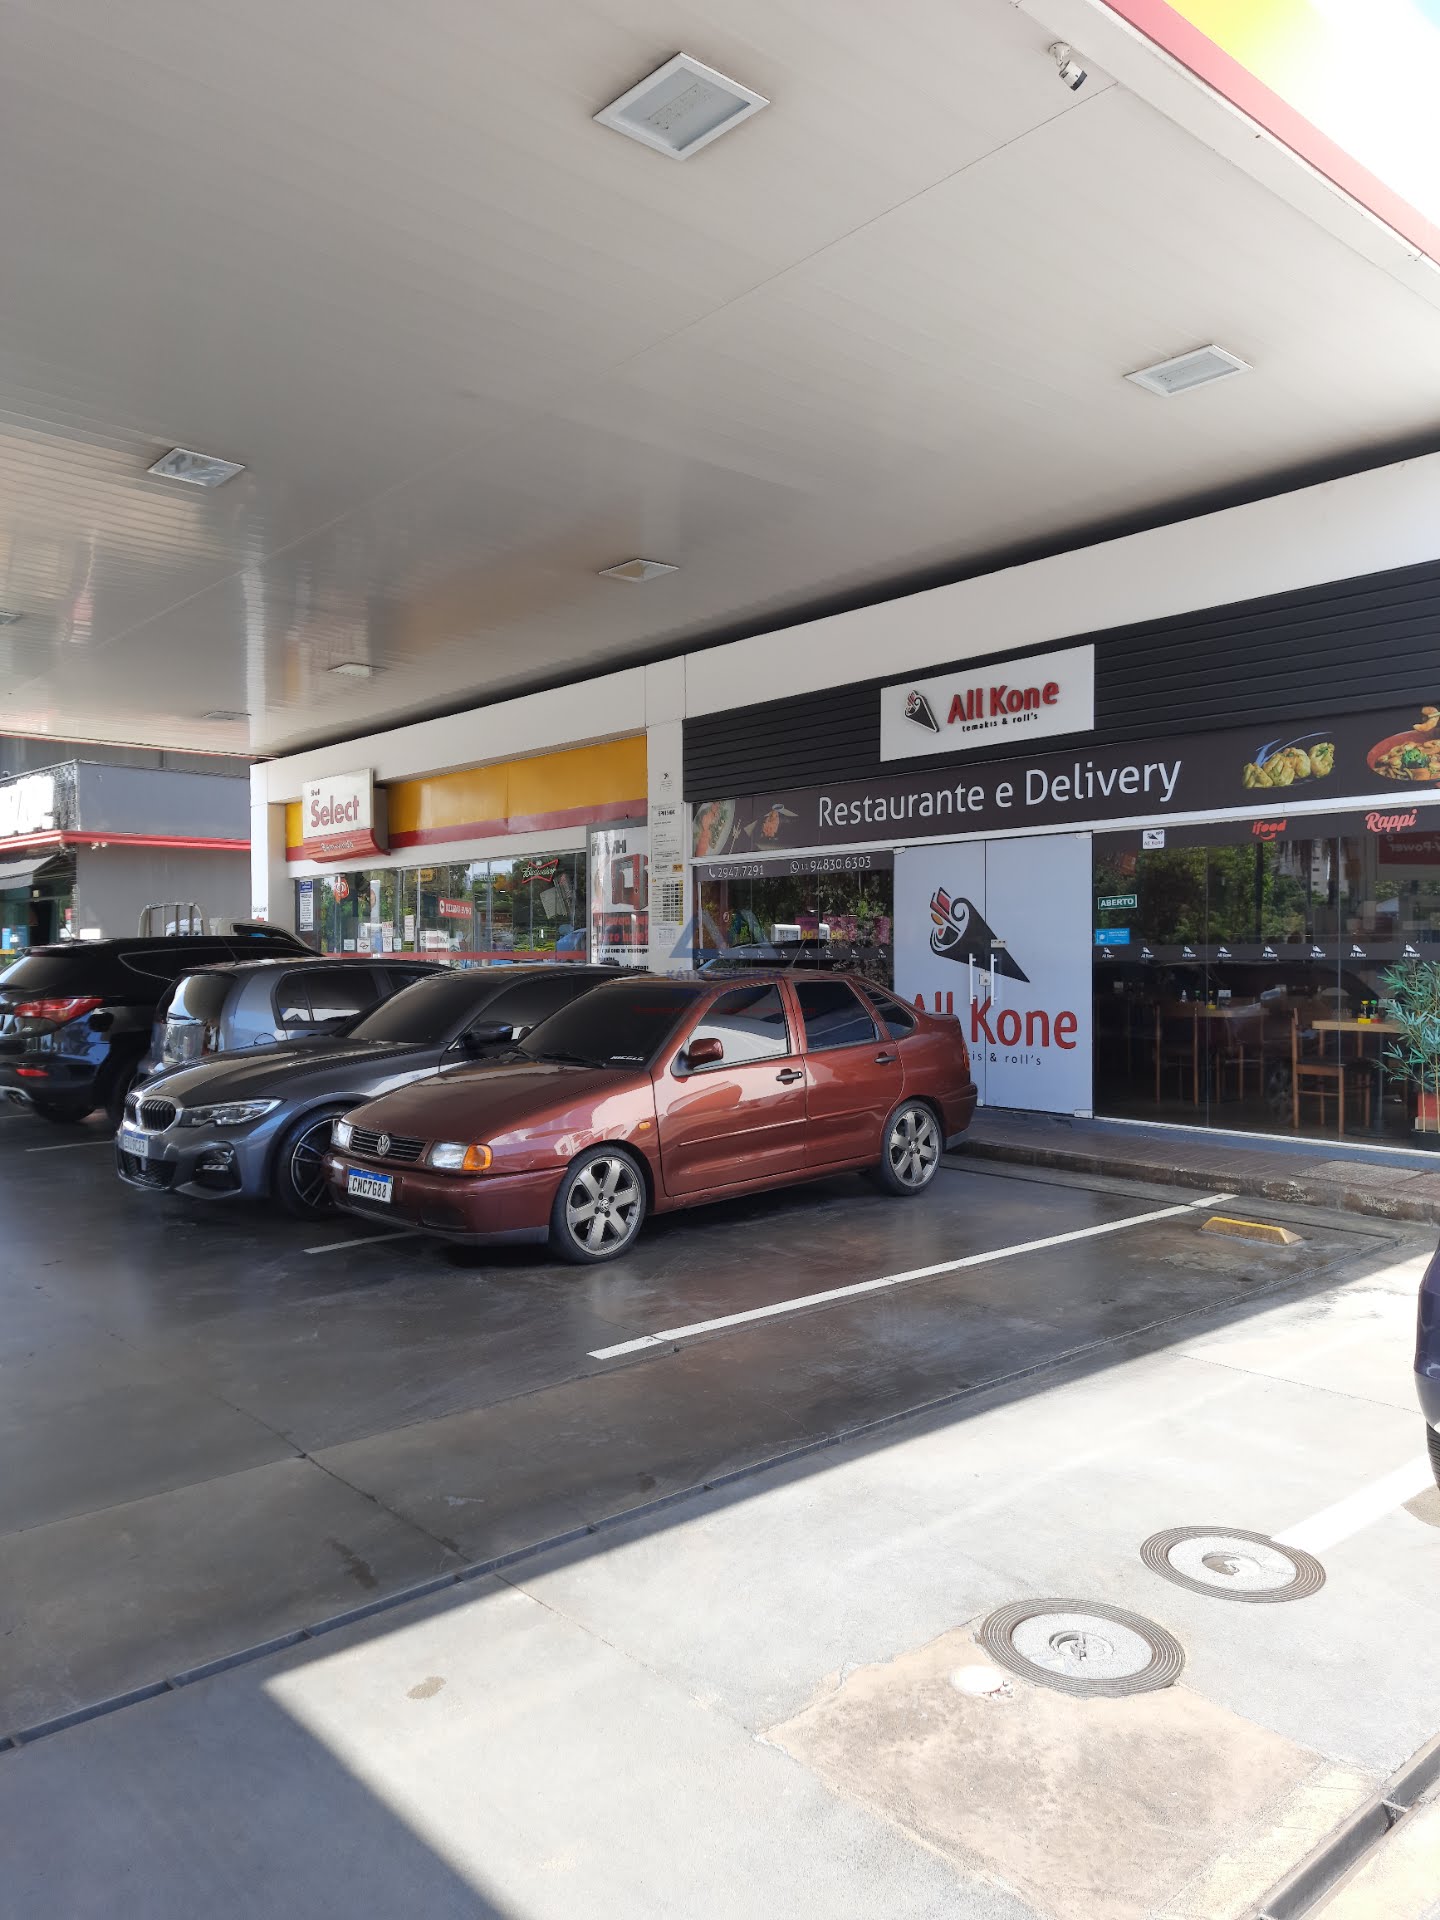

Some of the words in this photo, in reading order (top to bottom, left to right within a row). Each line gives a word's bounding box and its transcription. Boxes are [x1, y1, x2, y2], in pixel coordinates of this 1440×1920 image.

[947, 688, 984, 724] All
[990, 681, 1060, 717] Kone
[962, 720, 998, 732] temakis
[1002, 717, 1008, 725] &
[1012, 712, 1038, 724] roll's
[818, 782, 985, 827] Restaurante
[995, 782, 1013, 808] e
[1025, 760, 1182, 805] Delivery
[311, 795, 359, 828] Select
[1365, 808, 1418, 832] Rappi
[718, 864, 764, 878] 2947.7291
[810, 856, 871, 872] 94830.6303
[1101, 898, 1134, 907] ABERTO
[971, 995, 1077, 1049] Kone
[990, 1052, 997, 1062] &
[1005, 1055, 1041, 1066] roll's
[352, 1178, 387, 1198] CNC7G88
